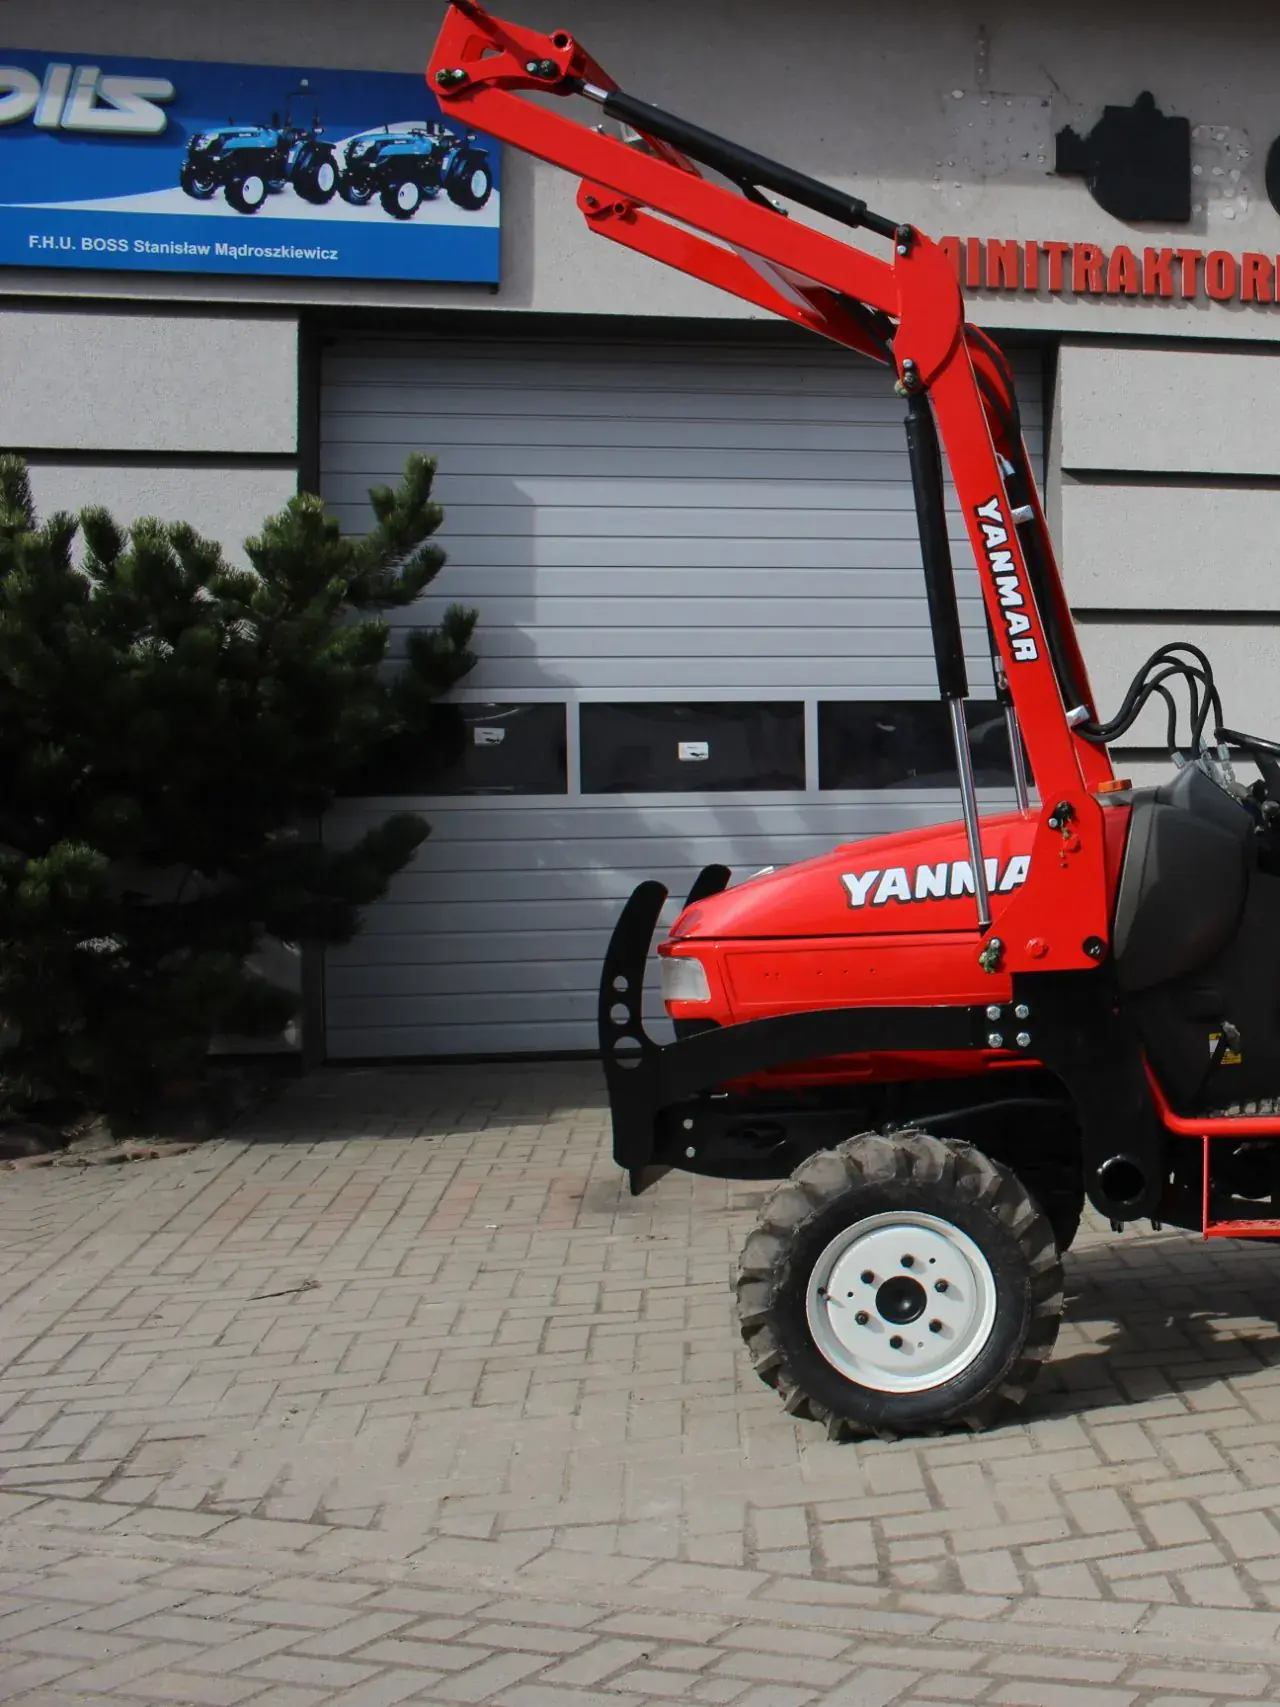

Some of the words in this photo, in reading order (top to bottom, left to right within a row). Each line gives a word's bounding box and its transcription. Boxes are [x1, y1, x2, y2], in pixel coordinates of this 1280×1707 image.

[29, 235, 76, 250] F.H.U.
[81, 237, 129, 252] BOSS
[134, 239, 211, 255] Stanisław
[215, 242, 339, 260] Mądroszkiewicz
[977, 498, 1037, 661] YANMAR
